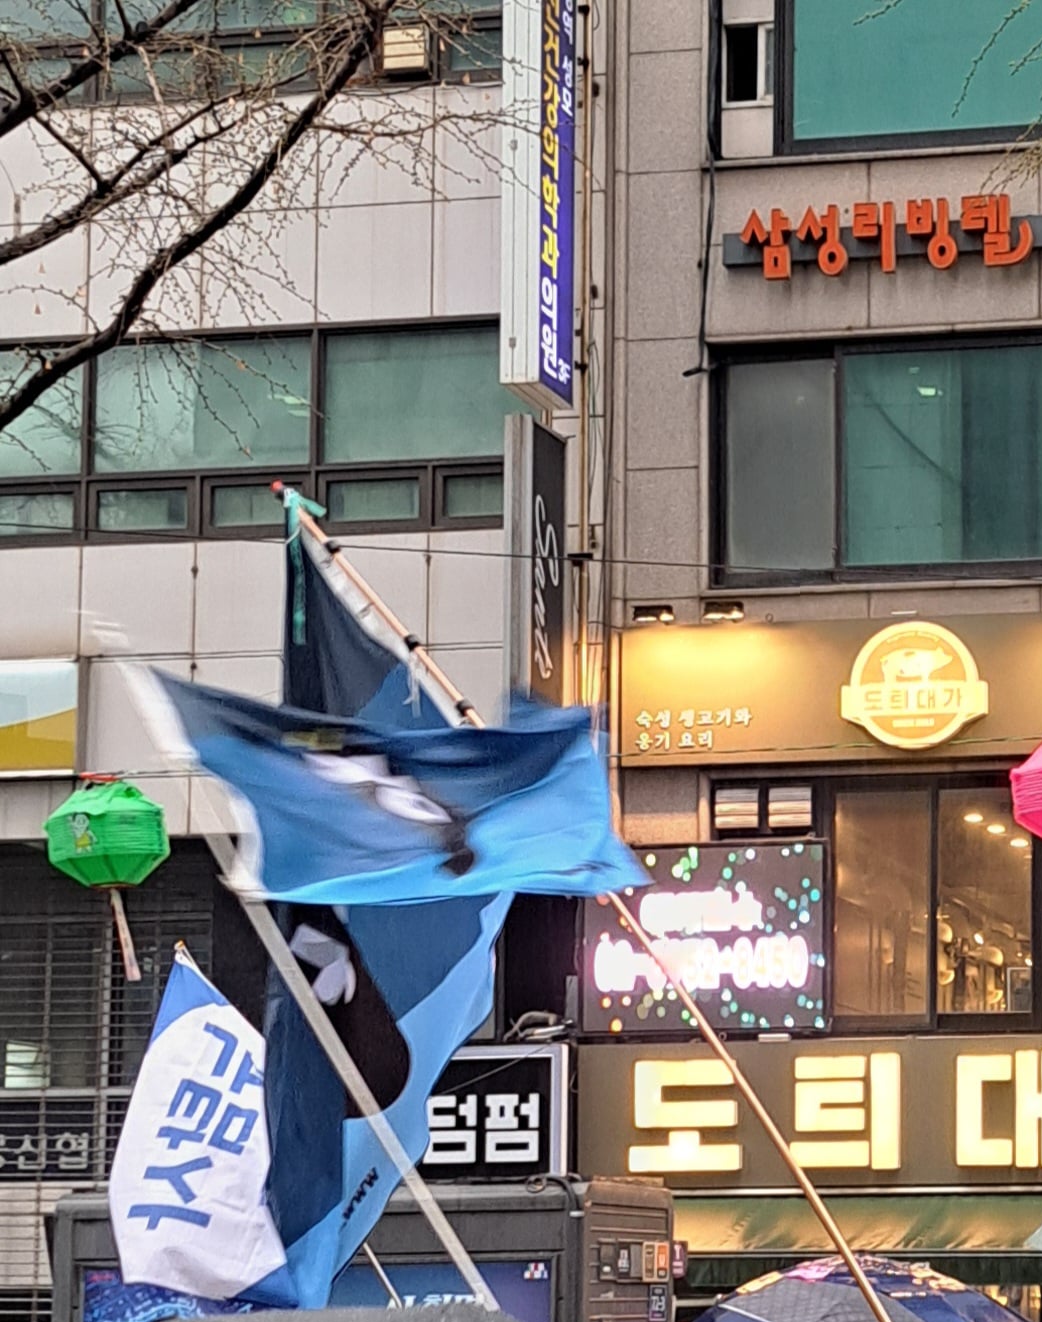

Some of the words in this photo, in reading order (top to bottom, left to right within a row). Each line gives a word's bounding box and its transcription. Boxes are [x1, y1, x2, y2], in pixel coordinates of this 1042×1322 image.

[739, 193, 1034, 280] 삼성리빙텔
[635, 710, 671, 729] 숙성
[678, 707, 752, 729] 생고기와
[678, 729, 713, 750] 요리
[0, 1132, 89, 1170] 신협
